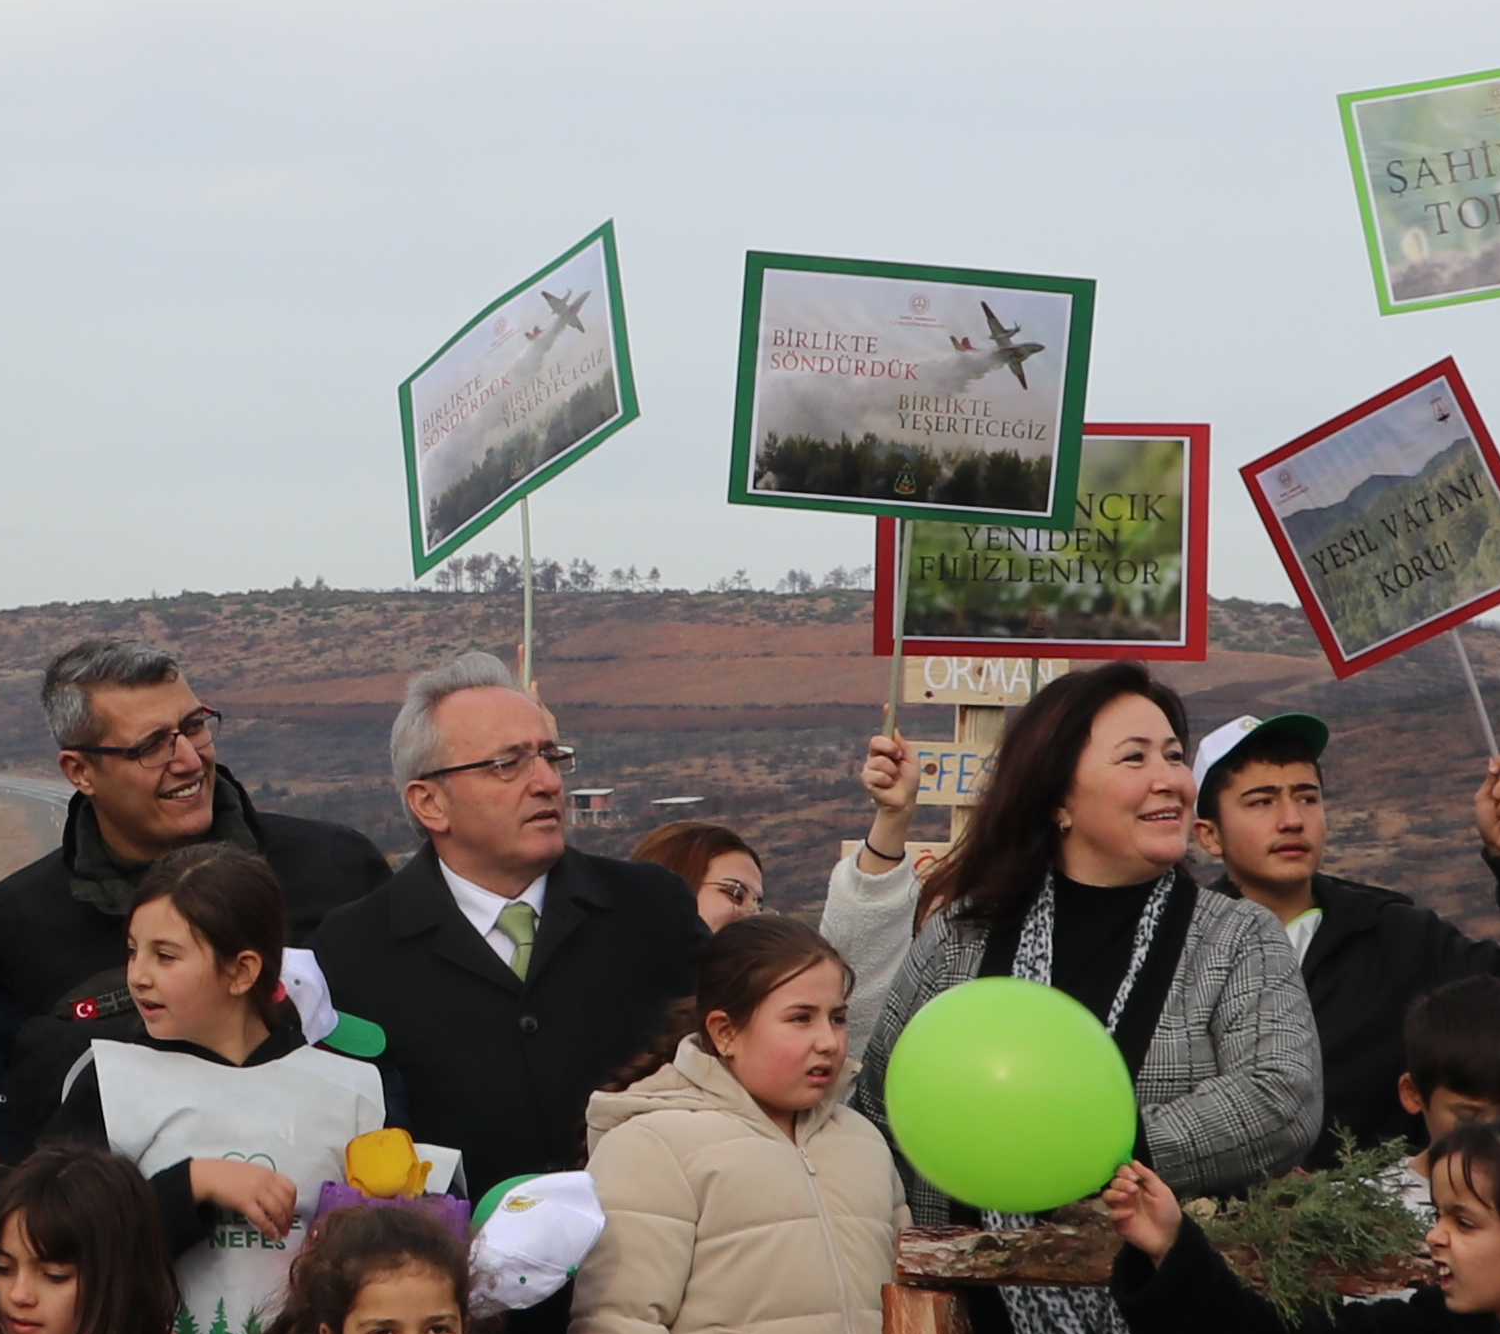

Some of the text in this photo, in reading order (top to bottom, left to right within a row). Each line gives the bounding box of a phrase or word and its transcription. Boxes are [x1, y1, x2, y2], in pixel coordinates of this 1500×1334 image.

[772, 327, 878, 354] BİRLİKTE
[770, 350, 920, 380] SÖNDÜRDÜK
[898, 391, 993, 418] BİRLİKTE
[898, 413, 1048, 441] YEŞERTECEĞİZ
[1381, 472, 1485, 540] VATANI
[918, 553, 1161, 586] FİLİZLENİYOR
[1375, 540, 1457, 599] KORU!
